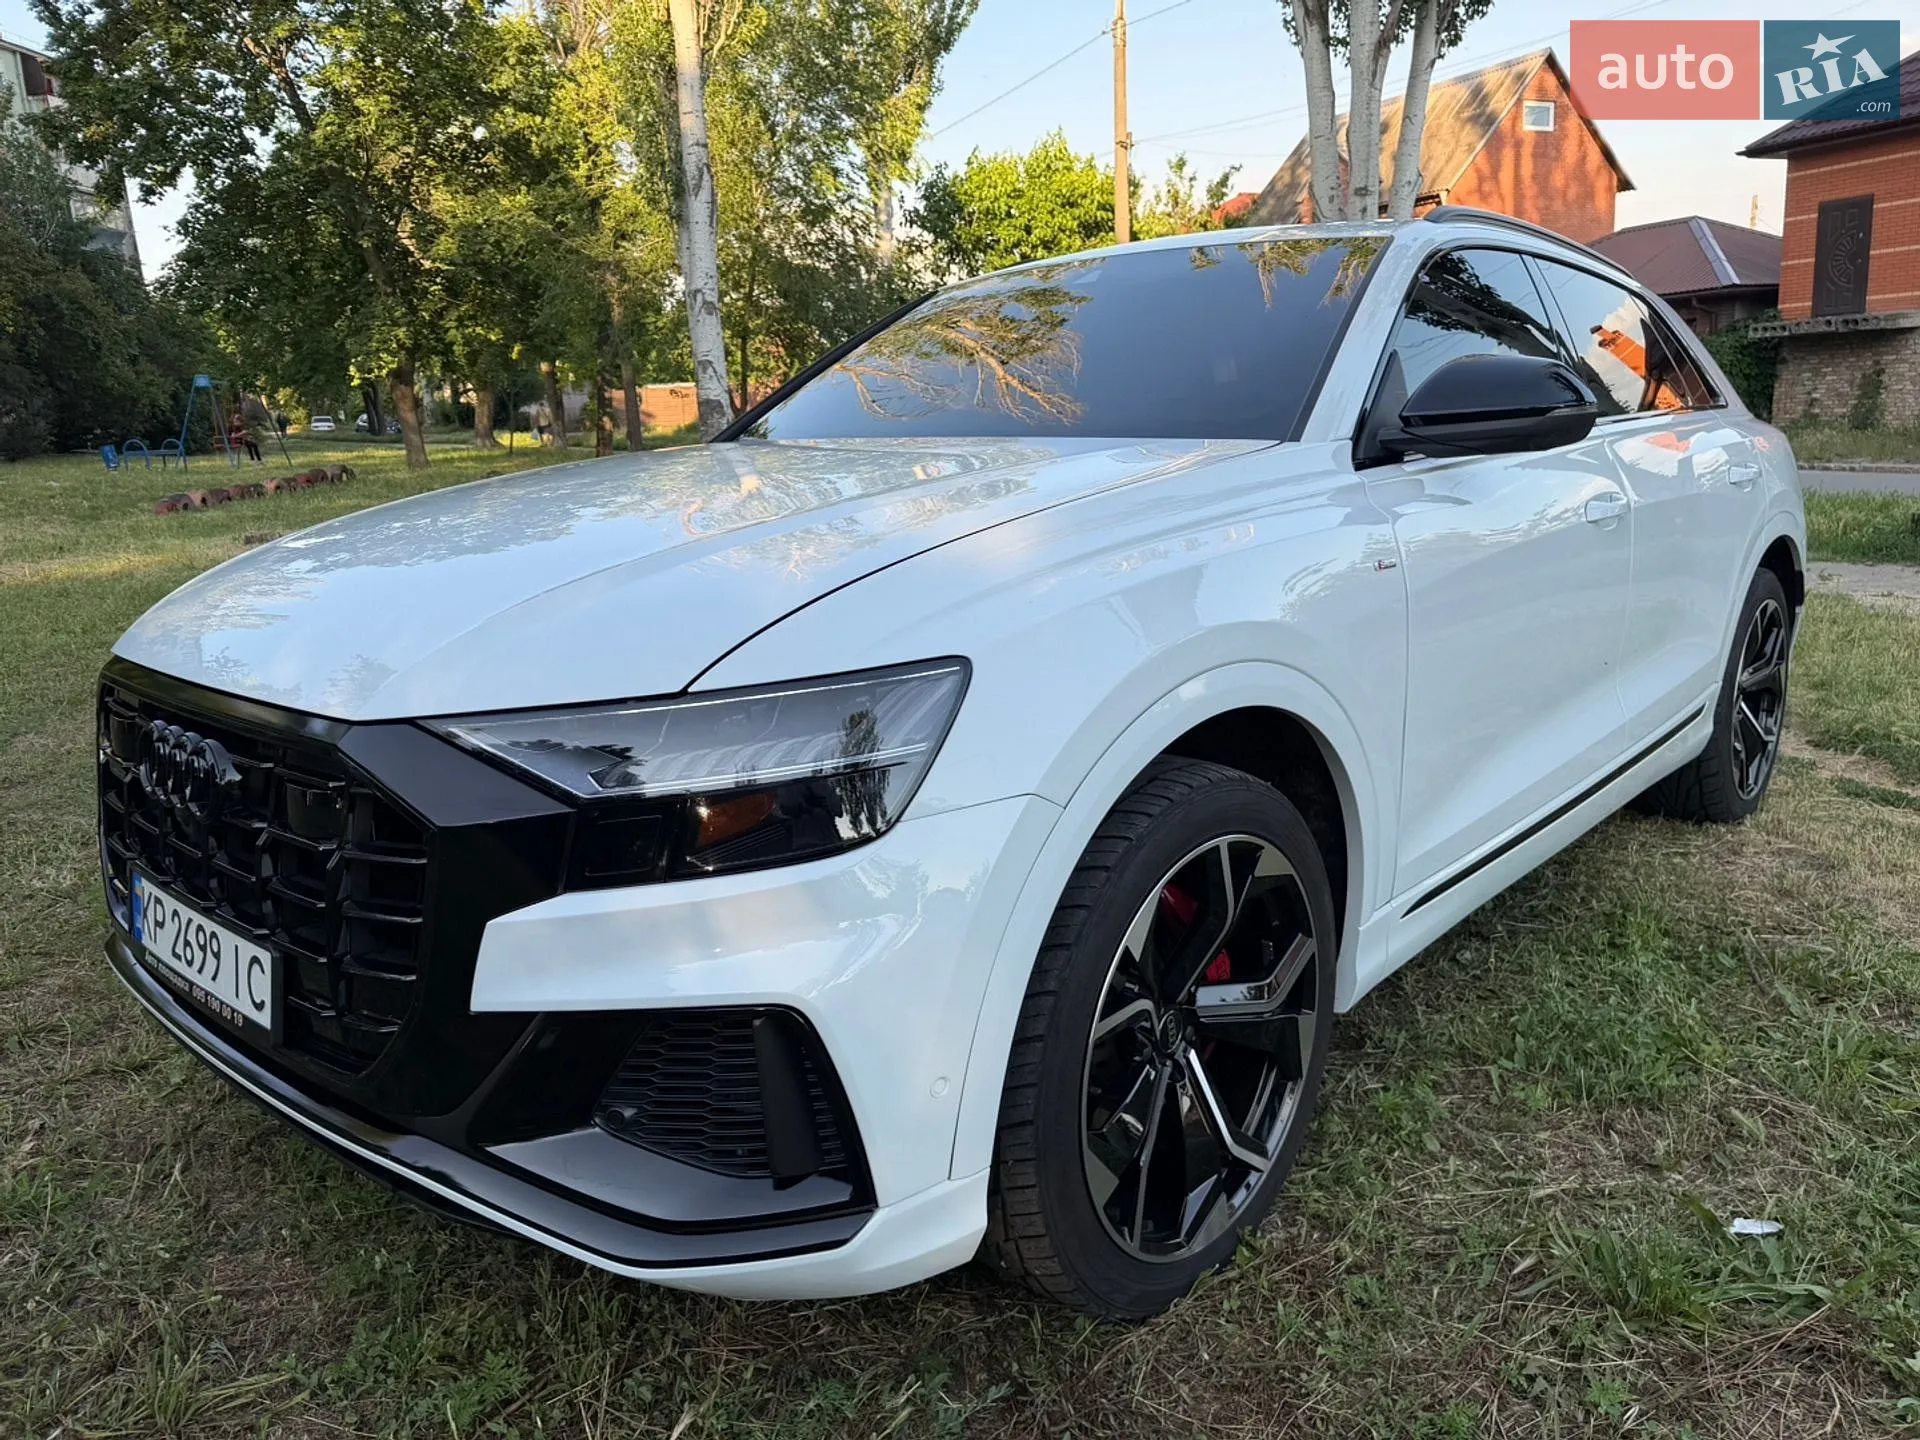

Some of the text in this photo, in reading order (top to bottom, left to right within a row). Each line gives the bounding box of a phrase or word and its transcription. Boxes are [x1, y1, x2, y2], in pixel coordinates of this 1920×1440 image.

[143, 891, 266, 1012] KP 2699 IC
[233, 1011, 243, 1027] 19
